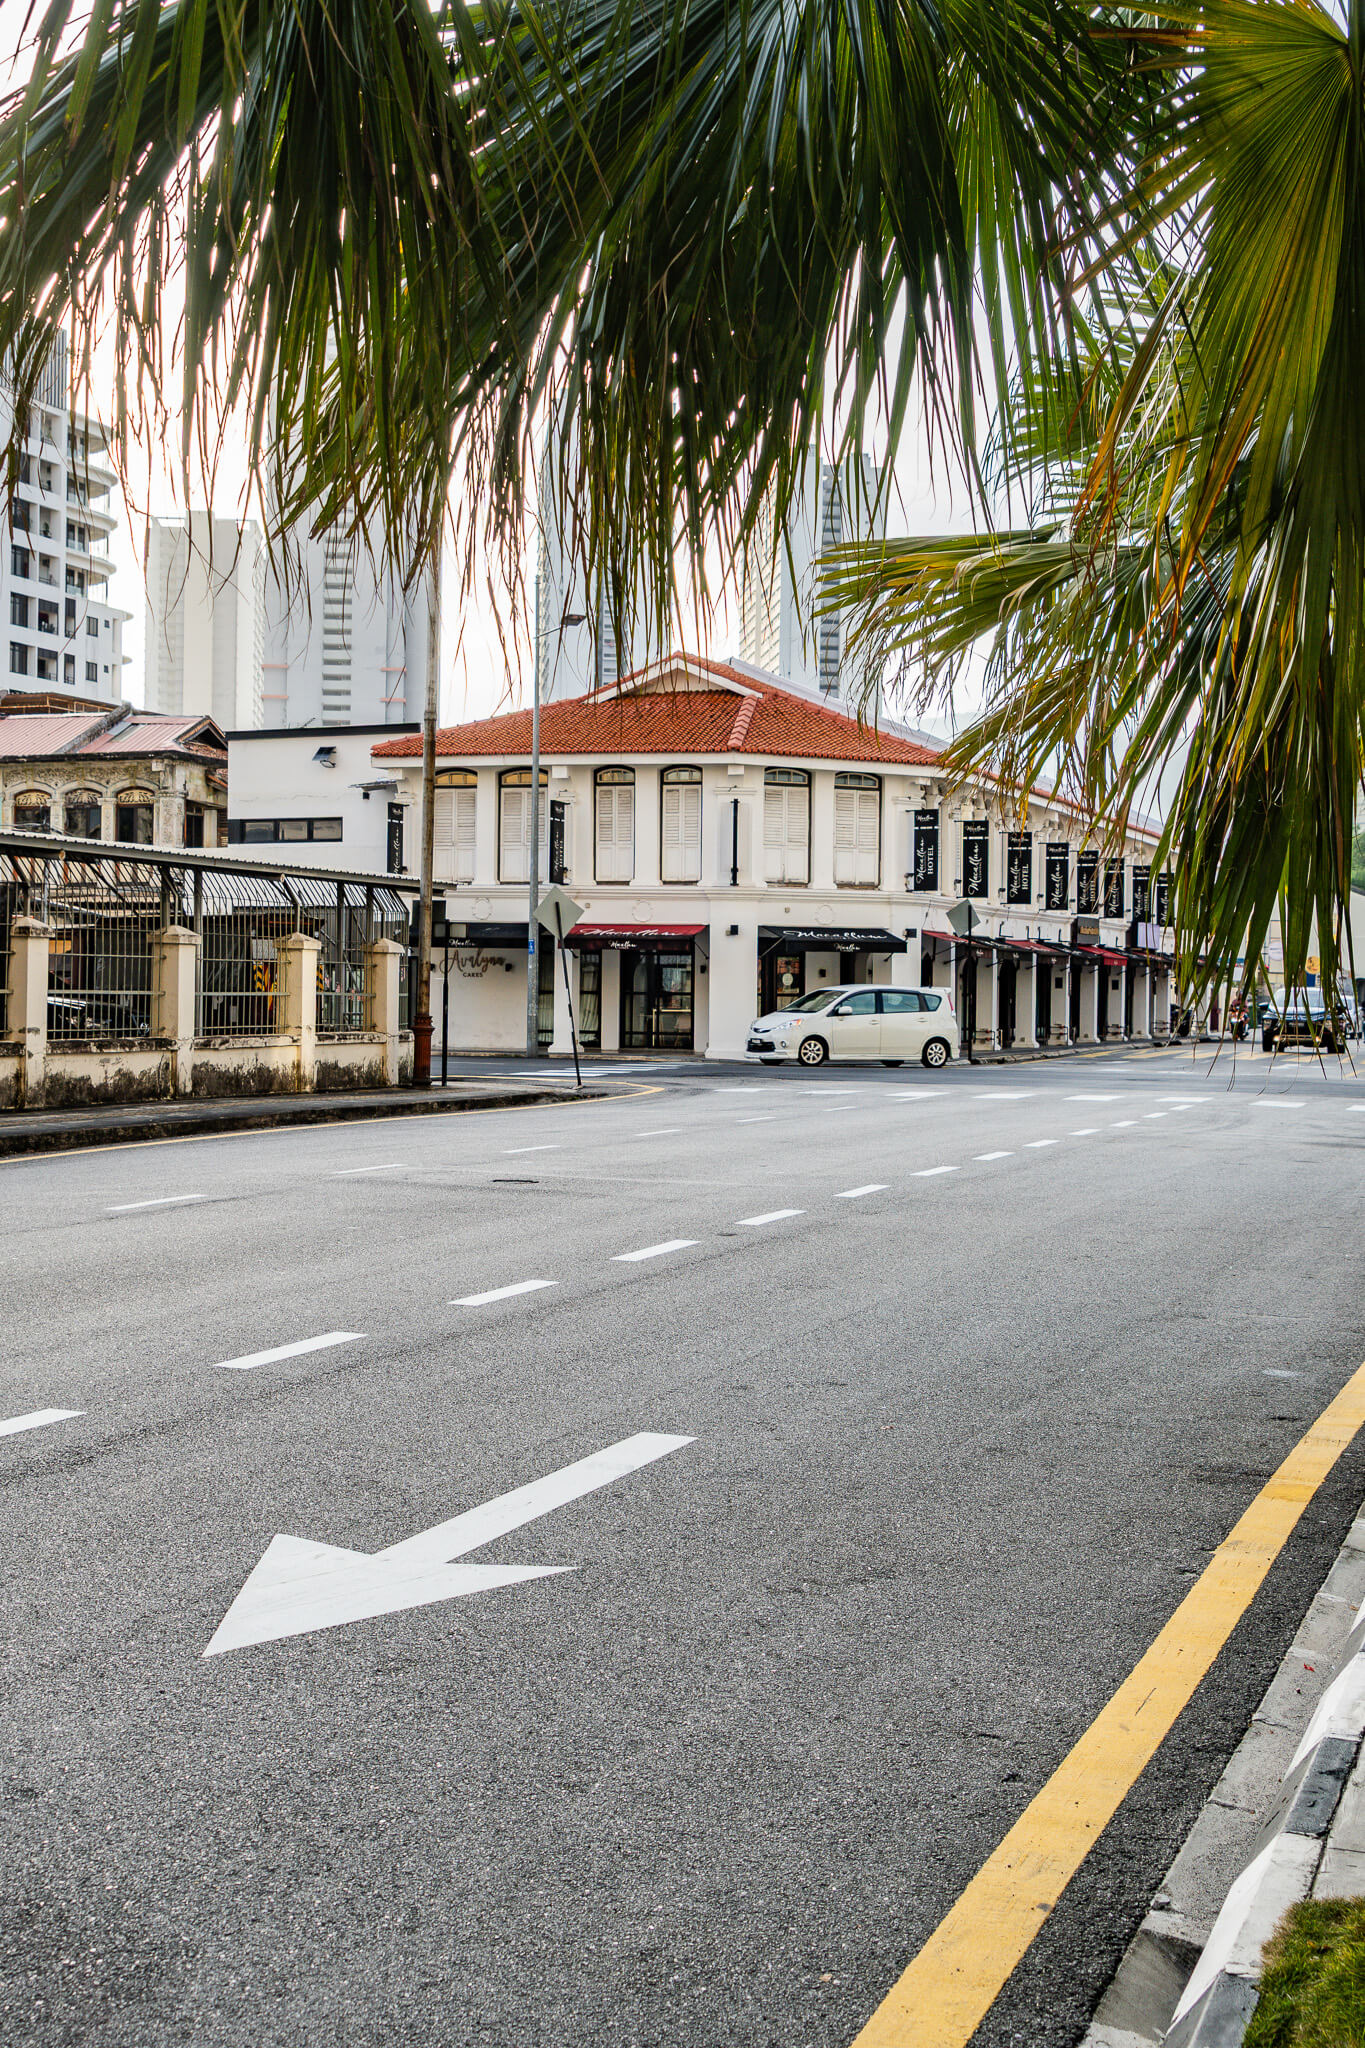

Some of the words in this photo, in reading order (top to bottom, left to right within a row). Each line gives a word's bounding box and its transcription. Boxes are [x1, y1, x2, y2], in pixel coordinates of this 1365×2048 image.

[915, 837, 926, 885] Macallum
[968, 842, 982, 895] Macallum
[783, 930, 888, 940] Macallum
